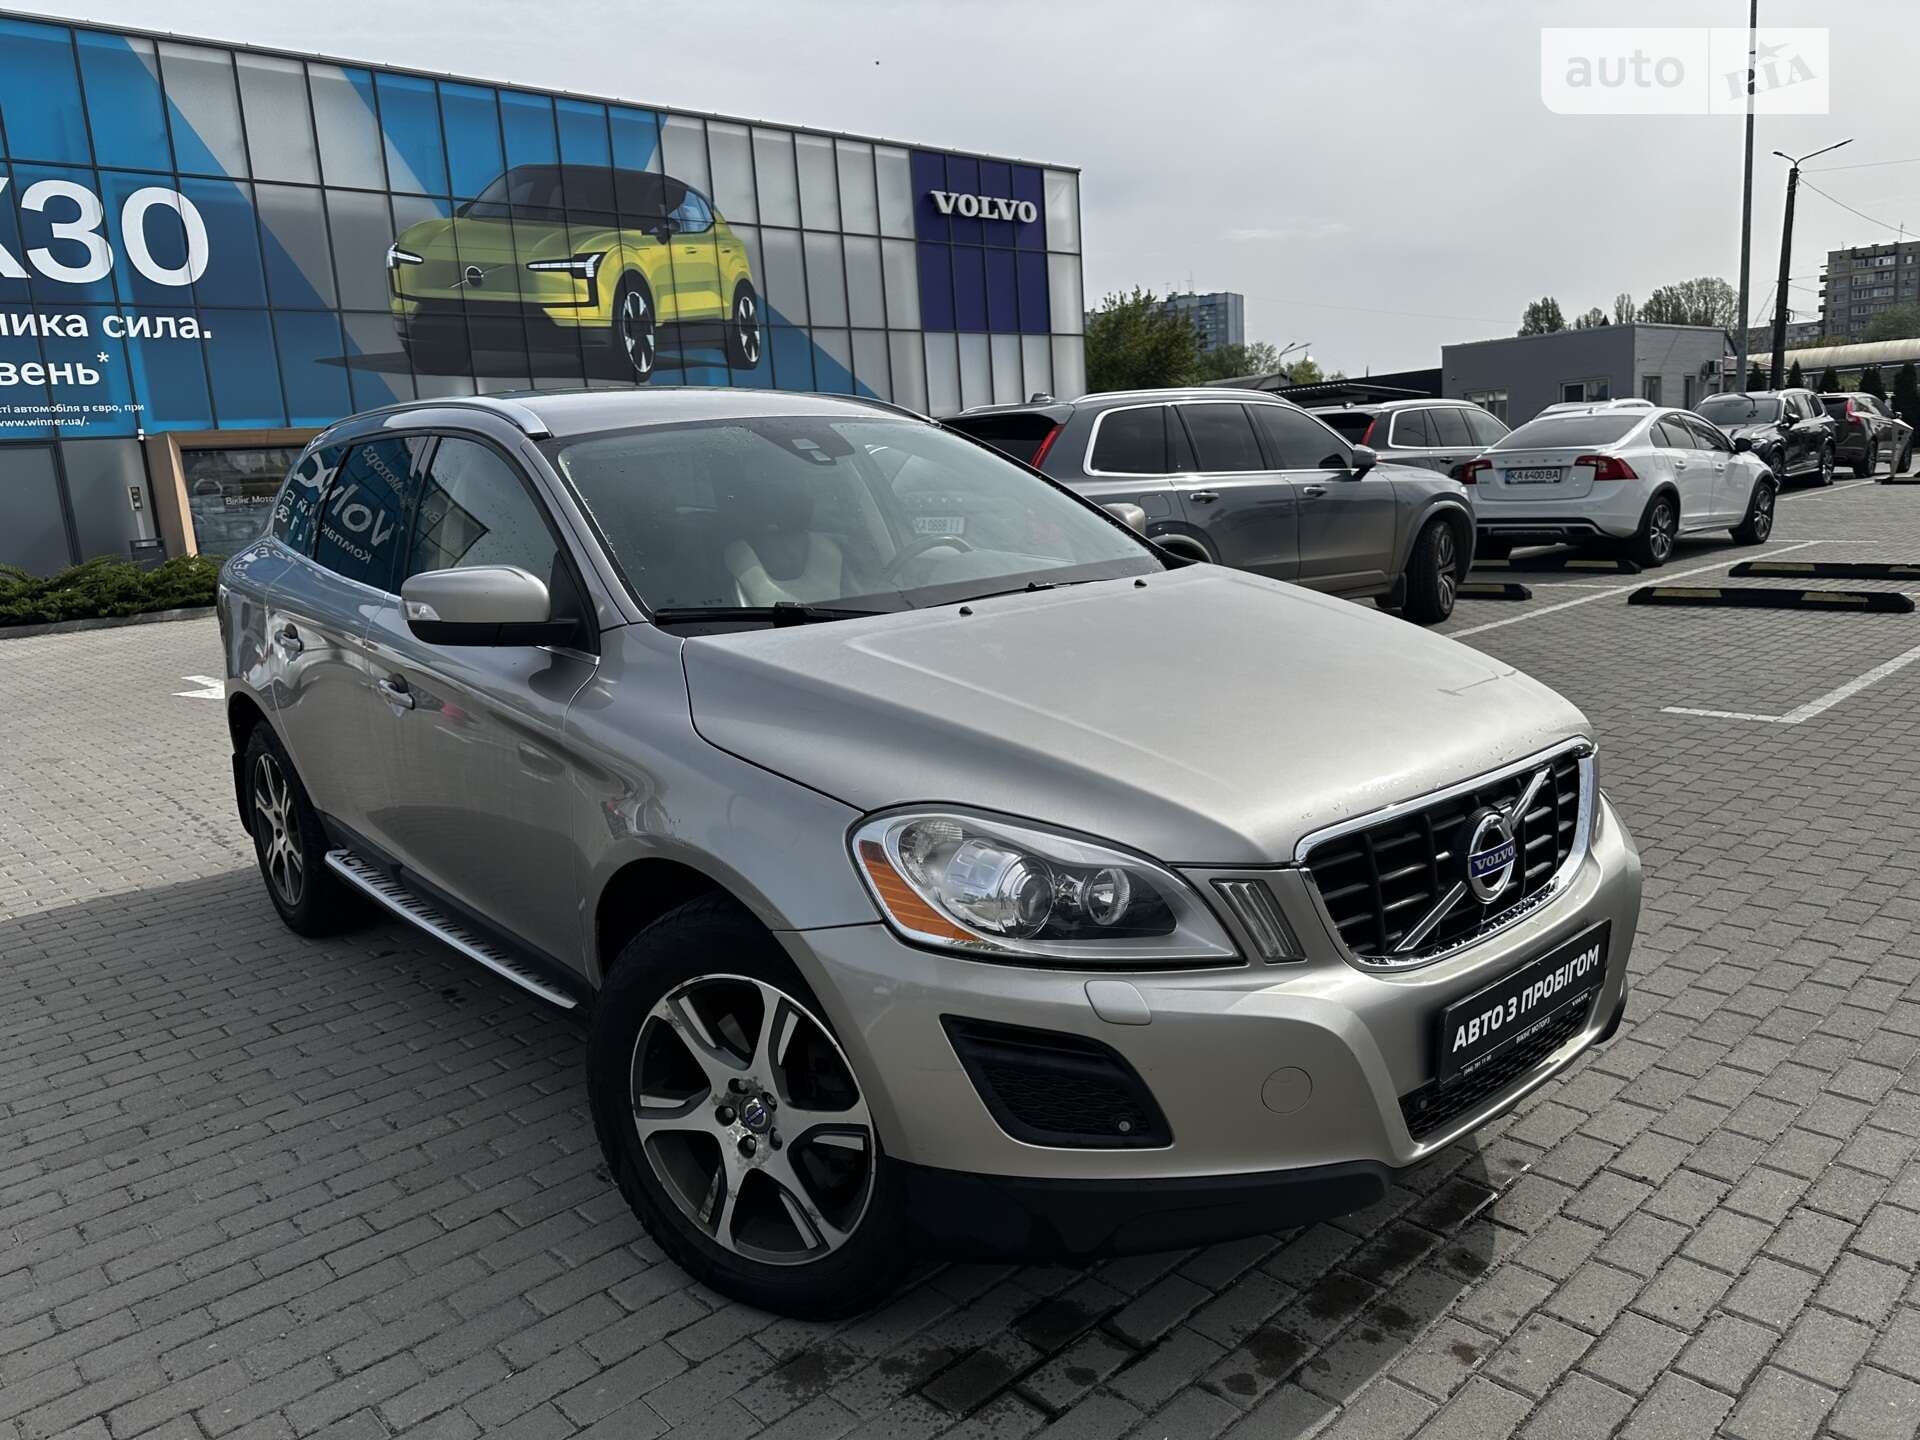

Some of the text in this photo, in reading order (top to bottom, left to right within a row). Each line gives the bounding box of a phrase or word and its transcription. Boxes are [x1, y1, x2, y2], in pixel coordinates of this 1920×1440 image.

[930, 190, 1038, 223] VOLVO
[102, 313, 212, 339] сила.
[13, 403, 80, 413] автомобіля
[92, 404, 122, 414] євро,
[124, 403, 145, 412] при
[1475, 845, 1514, 871] VOLVO
[1452, 1005, 1504, 1053] АВТО
[1520, 944, 1600, 1014] ПРОБІГОМ
